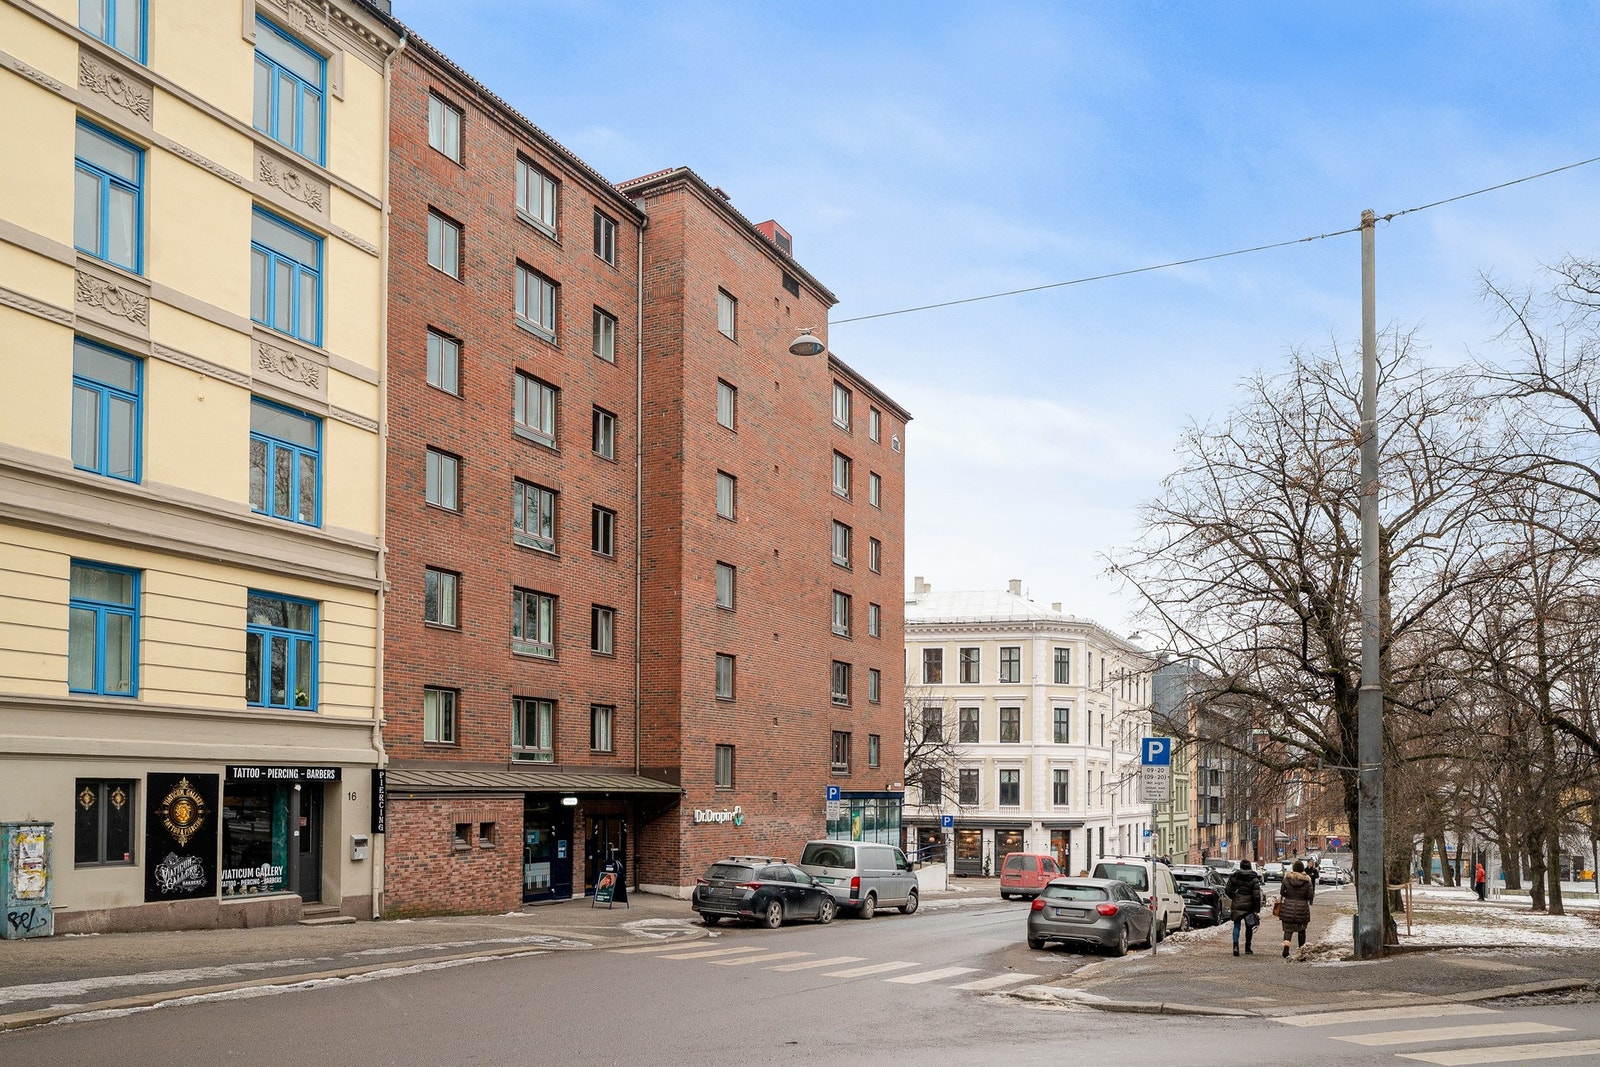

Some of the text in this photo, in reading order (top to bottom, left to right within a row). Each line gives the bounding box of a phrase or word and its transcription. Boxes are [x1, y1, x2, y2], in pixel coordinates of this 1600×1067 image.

[1148, 741, 1164, 762] P
[233, 767, 260, 778] TATTOO
[267, 768, 299, 779] PIERCING
[306, 769, 336, 779] BARBERS
[162, 789, 204, 806] VIATICUM GALLERY
[348, 791, 357, 801] 16
[829, 787, 837, 800] P
[944, 816, 951, 826] P
[255, 866, 284, 877] GALLERY
